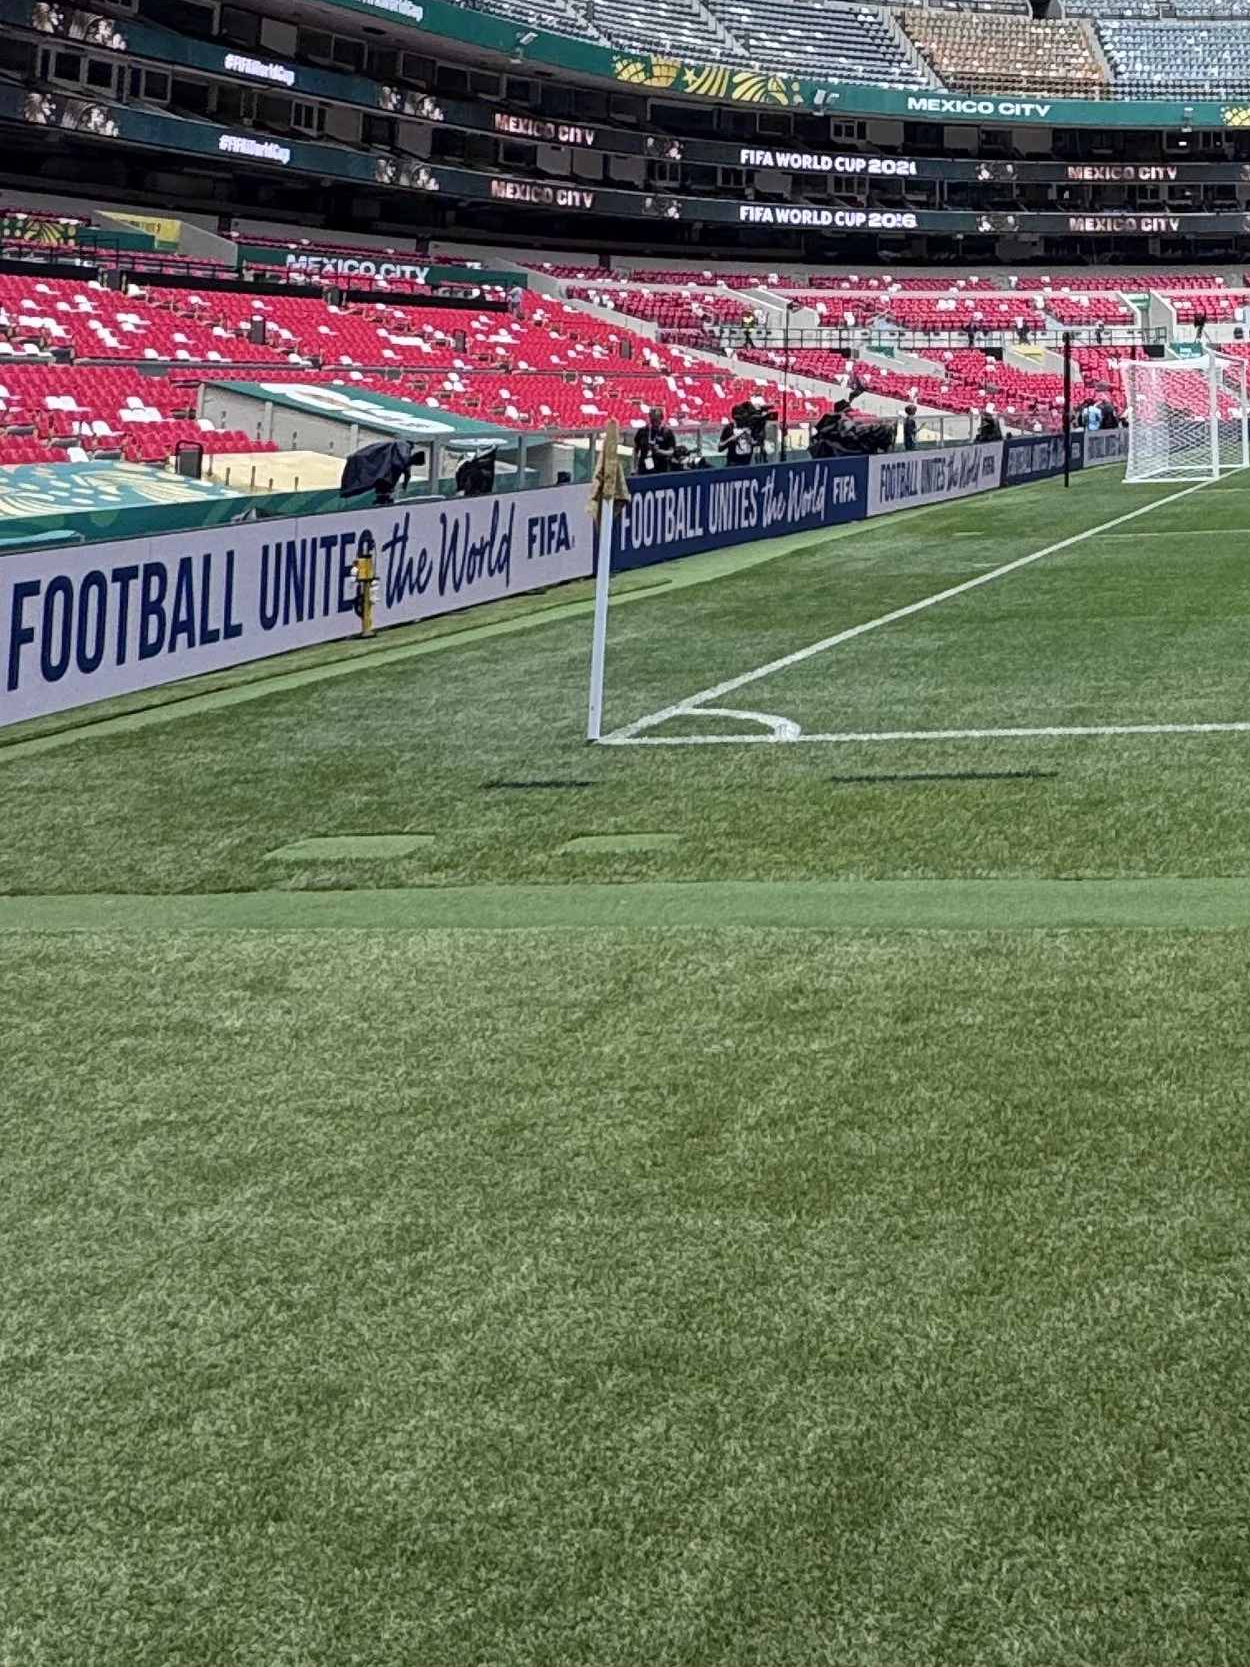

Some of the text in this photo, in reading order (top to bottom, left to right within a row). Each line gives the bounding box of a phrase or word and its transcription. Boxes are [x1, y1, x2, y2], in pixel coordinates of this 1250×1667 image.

[907, 96, 1052, 117] MEXICO CITY
[495, 113, 595, 145] MEXICO CITY
[740, 149, 774, 167] FIFA
[775, 151, 833, 170] WORLD
[834, 156, 867, 174] CUP
[1067, 166, 1177, 180] MEXICO CITY
[491, 180, 594, 209] MEXICO CITY
[739, 206, 774, 223] FIFA
[775, 207, 833, 226] WORLD
[834, 211, 867, 227] CUP
[1069, 217, 1180, 232] MEXICO CITY
[286, 254, 430, 283] MEXICO CITY
[880, 458, 918, 503] FOOTBALL
[620, 464, 857, 551] FOOTBALL UNITES the World FIFA
[7, 550, 243, 692] FOOTBALL
[381, 512, 433, 609] the
[439, 500, 516, 597] World
[527, 511, 571, 559] FIFA
